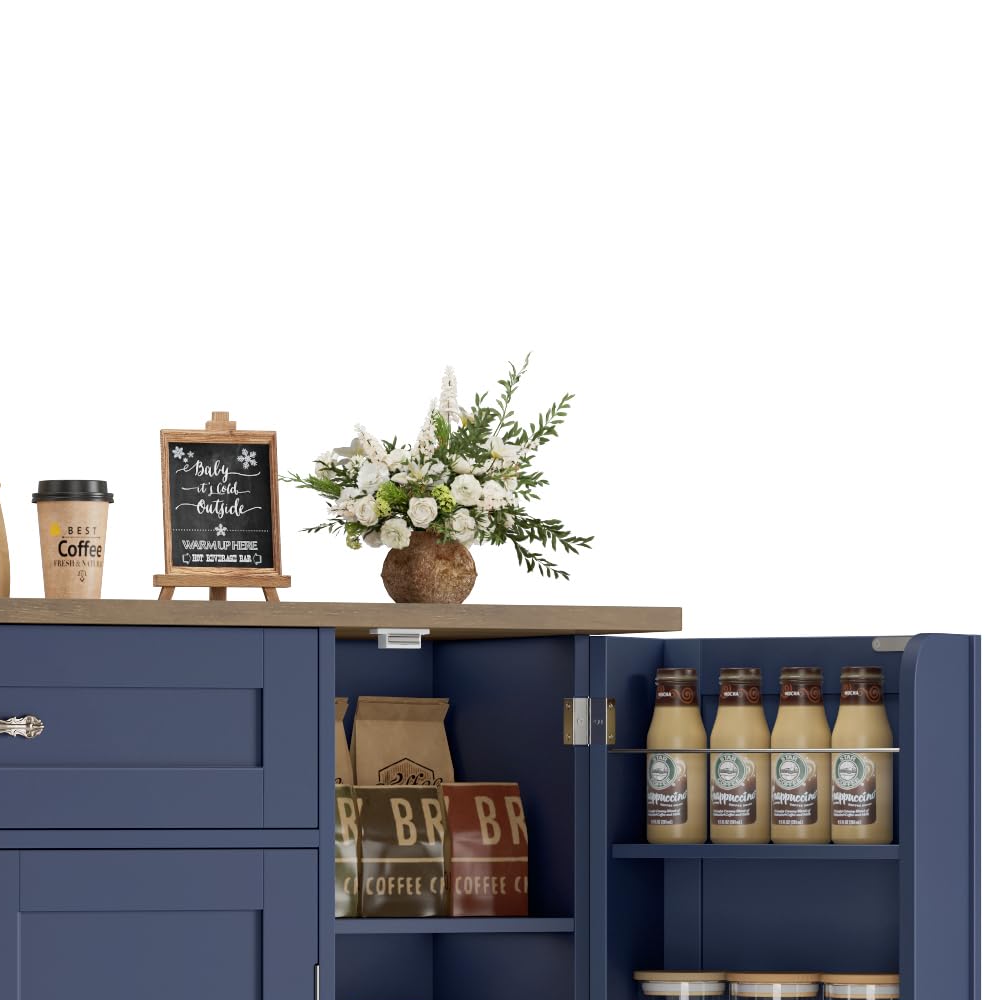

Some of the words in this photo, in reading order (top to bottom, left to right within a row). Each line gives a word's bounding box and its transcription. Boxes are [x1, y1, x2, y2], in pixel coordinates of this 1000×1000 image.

[67, 526, 97, 535] BEST
[58, 539, 103, 558] Coffee
[181, 540, 217, 551] WARM
[217, 541, 231, 551] UP
[231, 541, 259, 551] HERE
[365, 876, 422, 896] COFFEE
[455, 876, 506, 895] COFFEE
